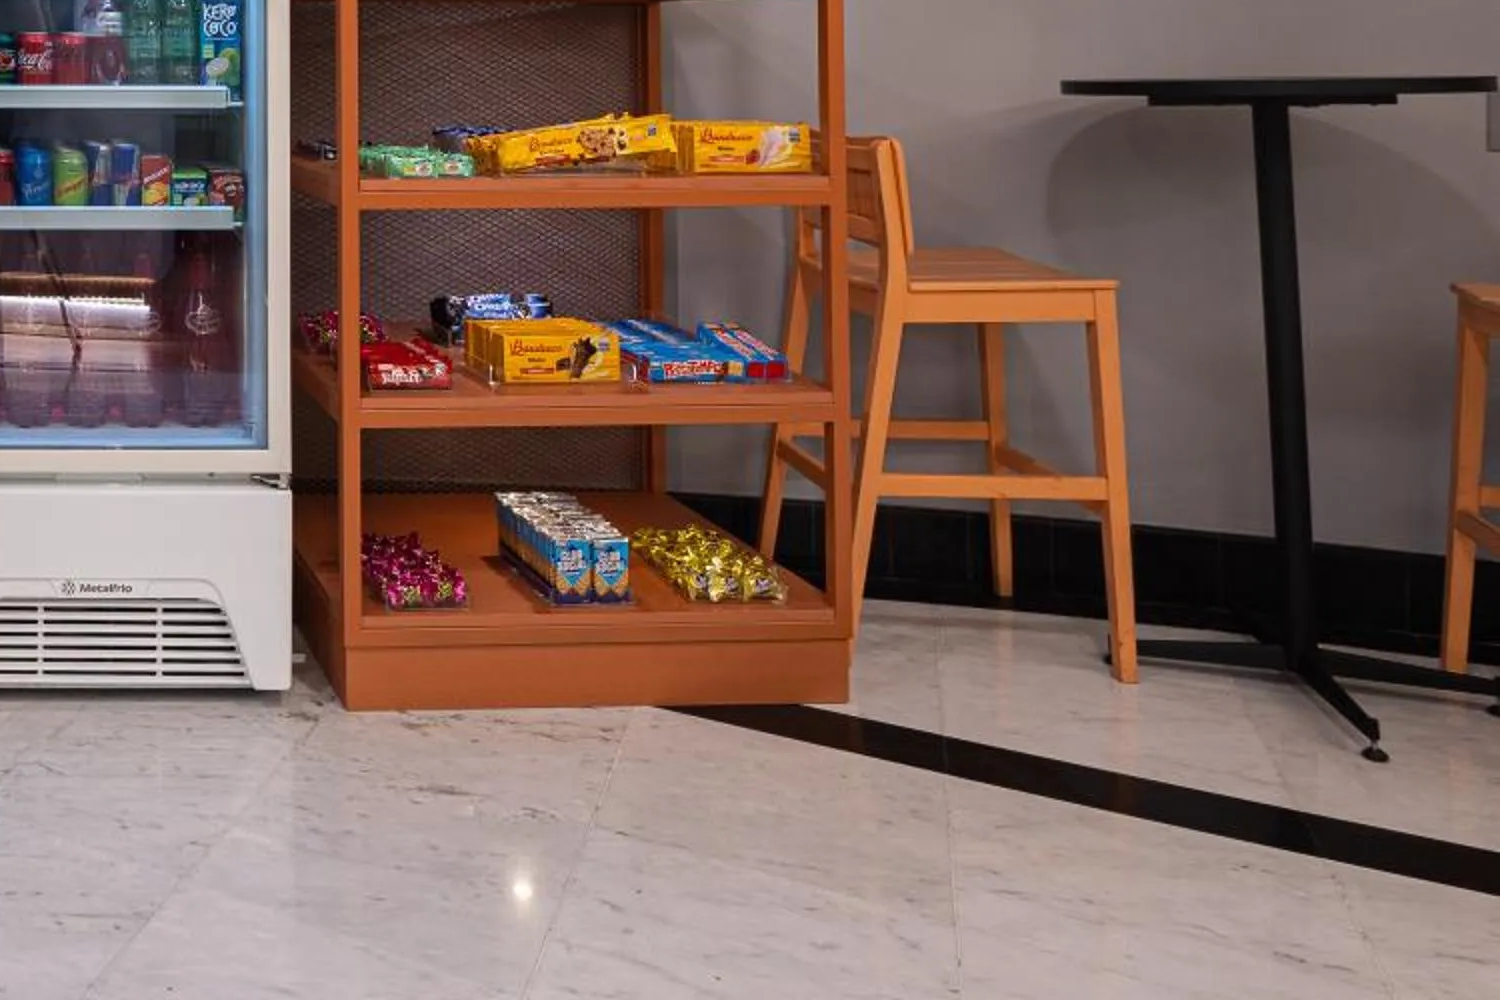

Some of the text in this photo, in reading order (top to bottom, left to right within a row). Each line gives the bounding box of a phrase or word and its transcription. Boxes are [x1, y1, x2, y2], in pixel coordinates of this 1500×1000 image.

[203, 3, 237, 20] KERO
[203, 20, 237, 37] COCO
[80, 583, 133, 593] Metalfrio
